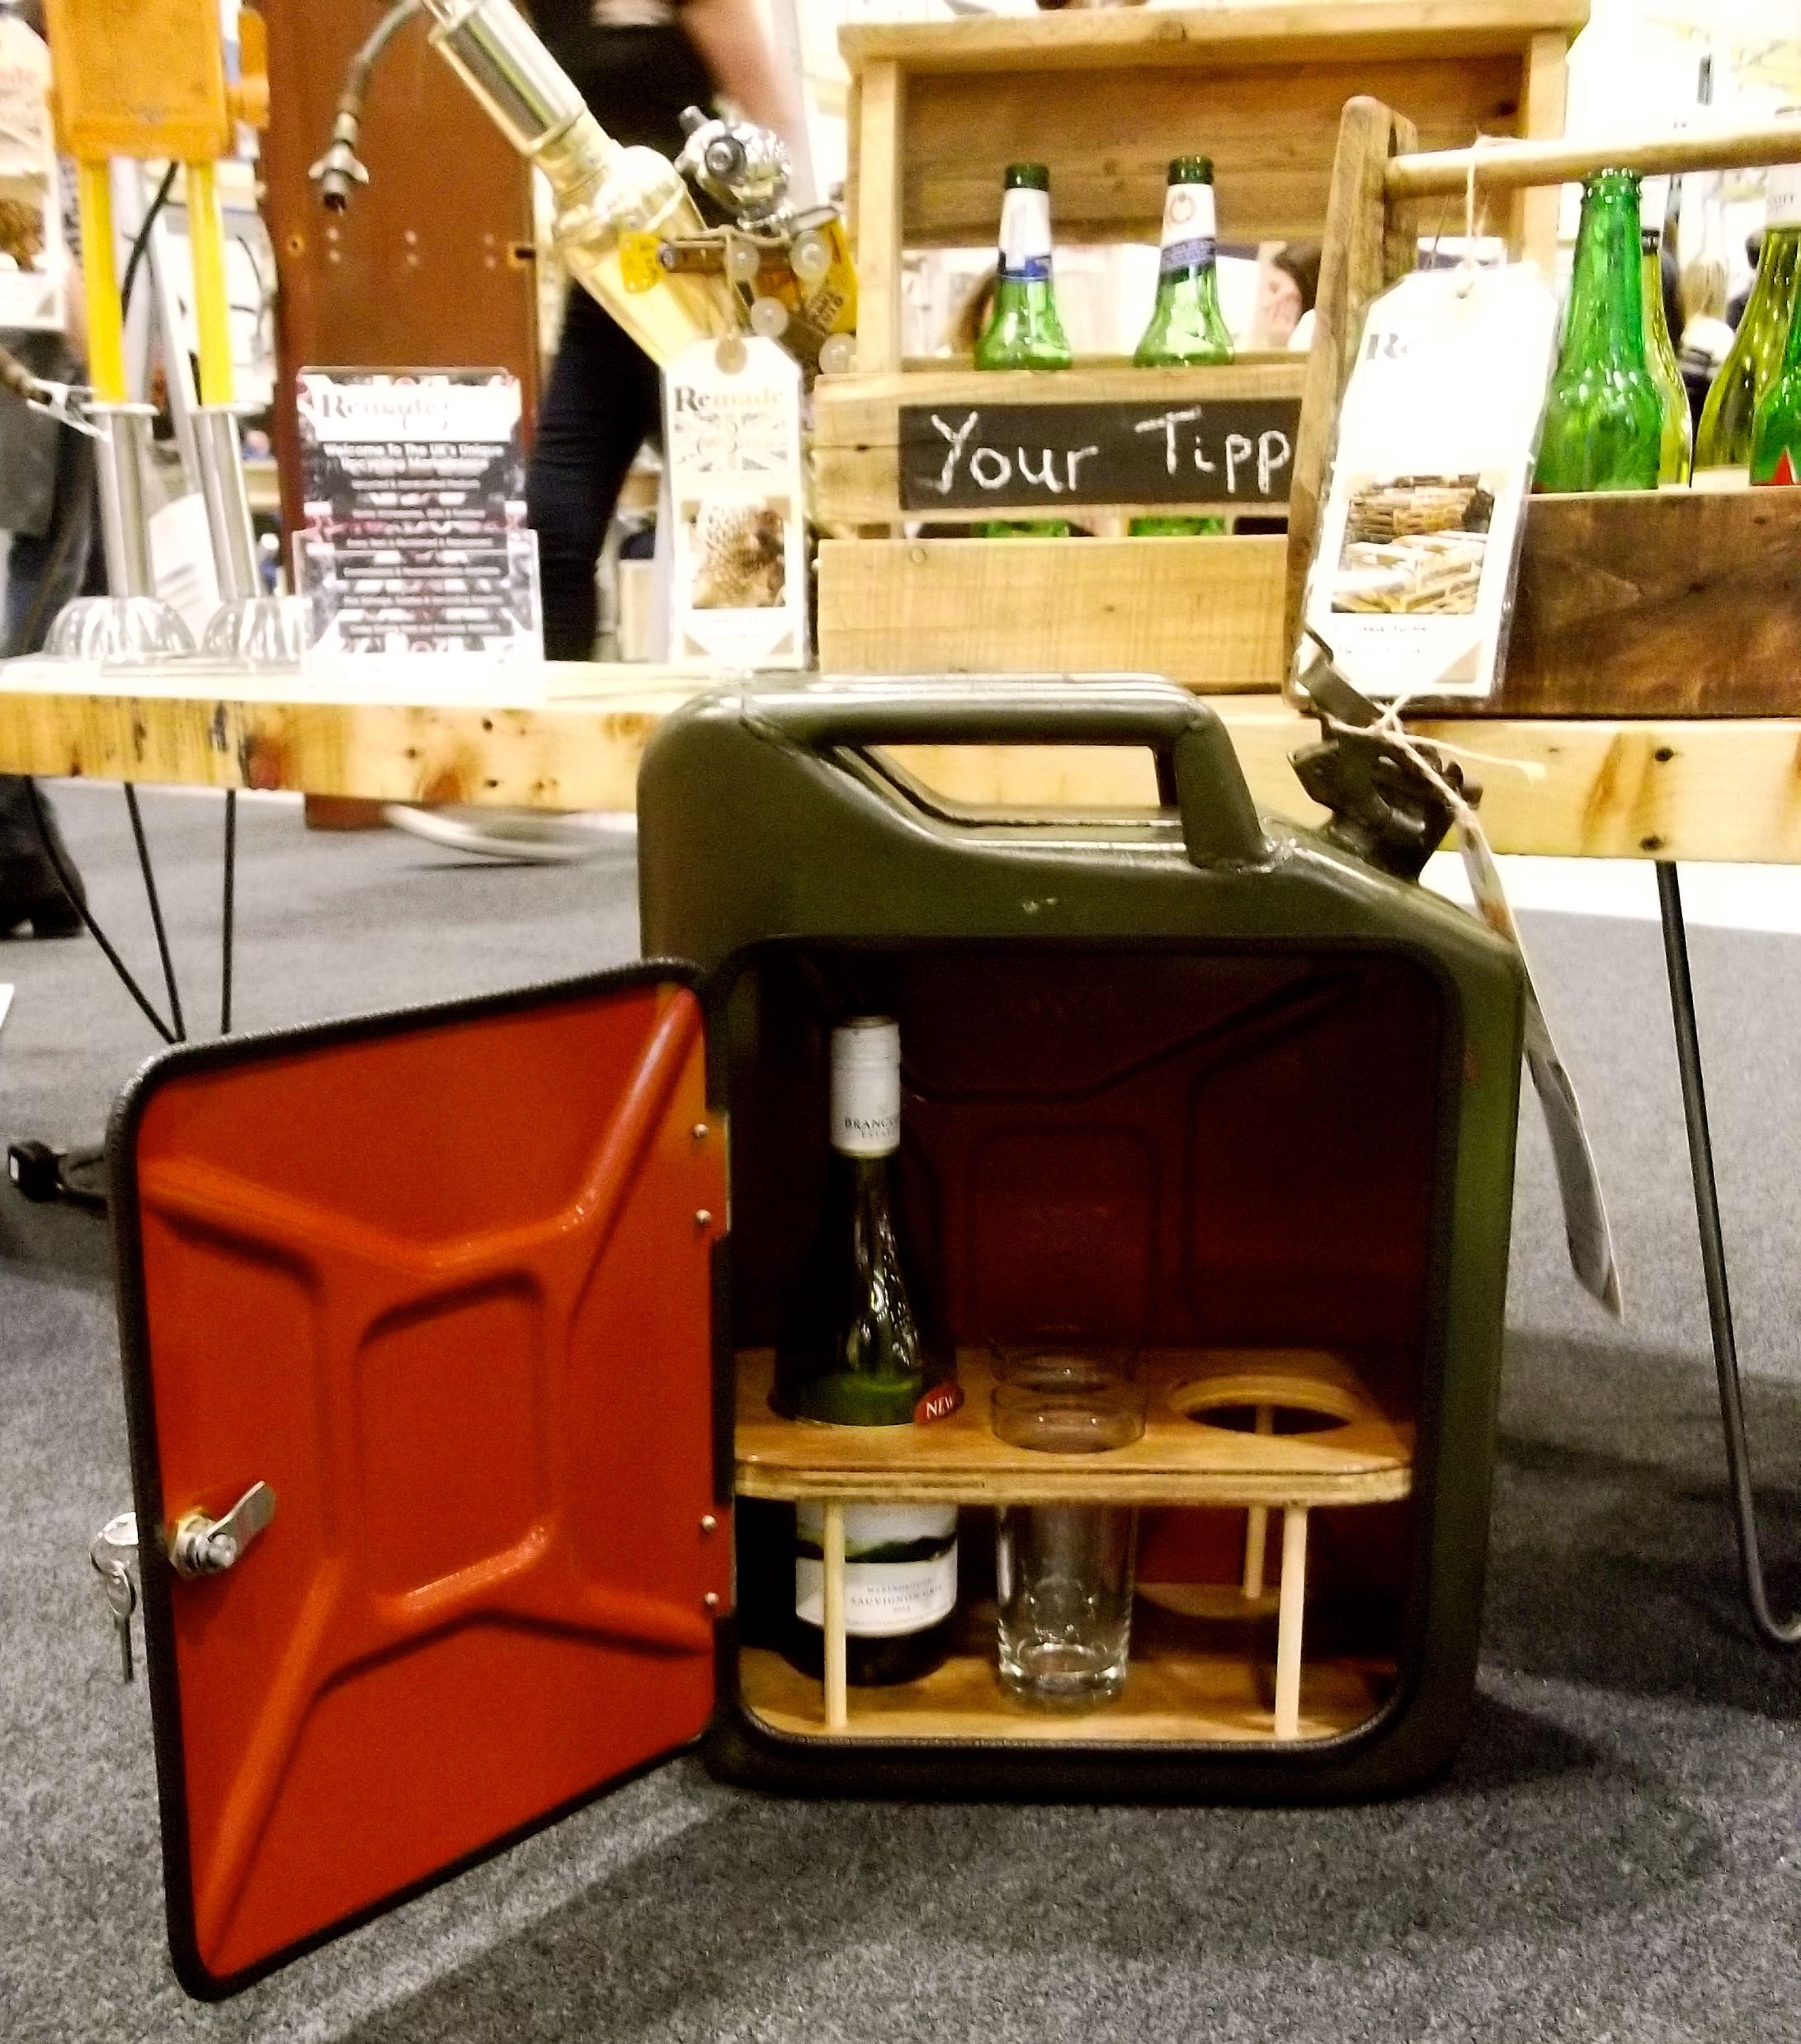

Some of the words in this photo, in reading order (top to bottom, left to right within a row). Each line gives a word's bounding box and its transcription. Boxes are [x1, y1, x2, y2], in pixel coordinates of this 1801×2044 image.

[673, 385, 785, 412] Remade
[916, 411, 1099, 495] Your
[1134, 405, 1291, 495] Tipp
[926, 1394, 955, 1419] NEW
